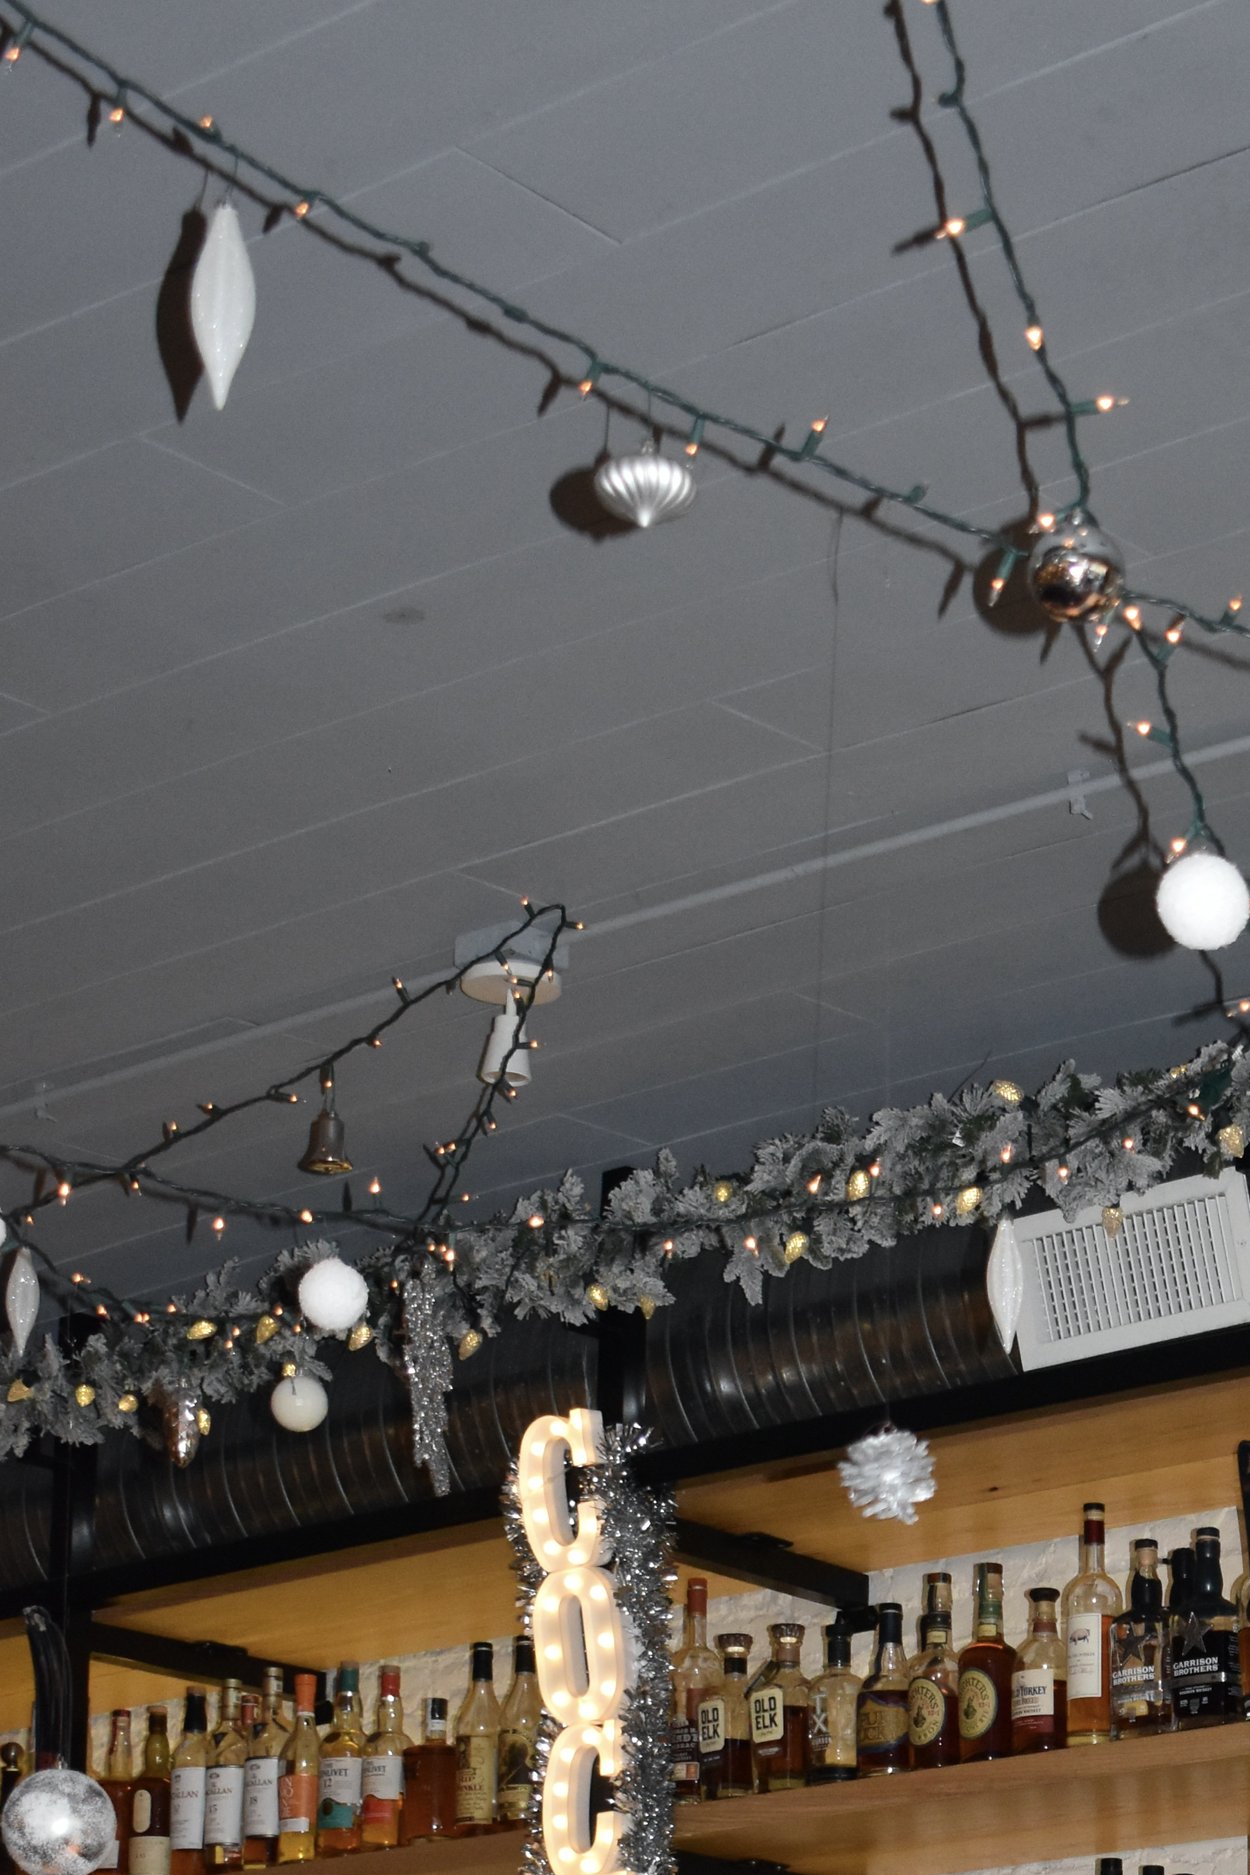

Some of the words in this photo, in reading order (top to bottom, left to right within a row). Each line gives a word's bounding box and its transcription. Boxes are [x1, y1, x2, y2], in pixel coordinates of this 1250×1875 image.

[1172, 1656, 1219, 1670] GARRISON
[1112, 1665, 1155, 1679] GARRISON
[1173, 1665, 1219, 1677] BROTHERS
[1113, 1672, 1155, 1686] BROTHERS
[1020, 1685, 1047, 1696] TURKEY
[754, 1696, 777, 1714] OLD
[701, 1707, 720, 1724] OLD
[755, 1713, 778, 1730] ELK
[701, 1723, 720, 1741] ELK
